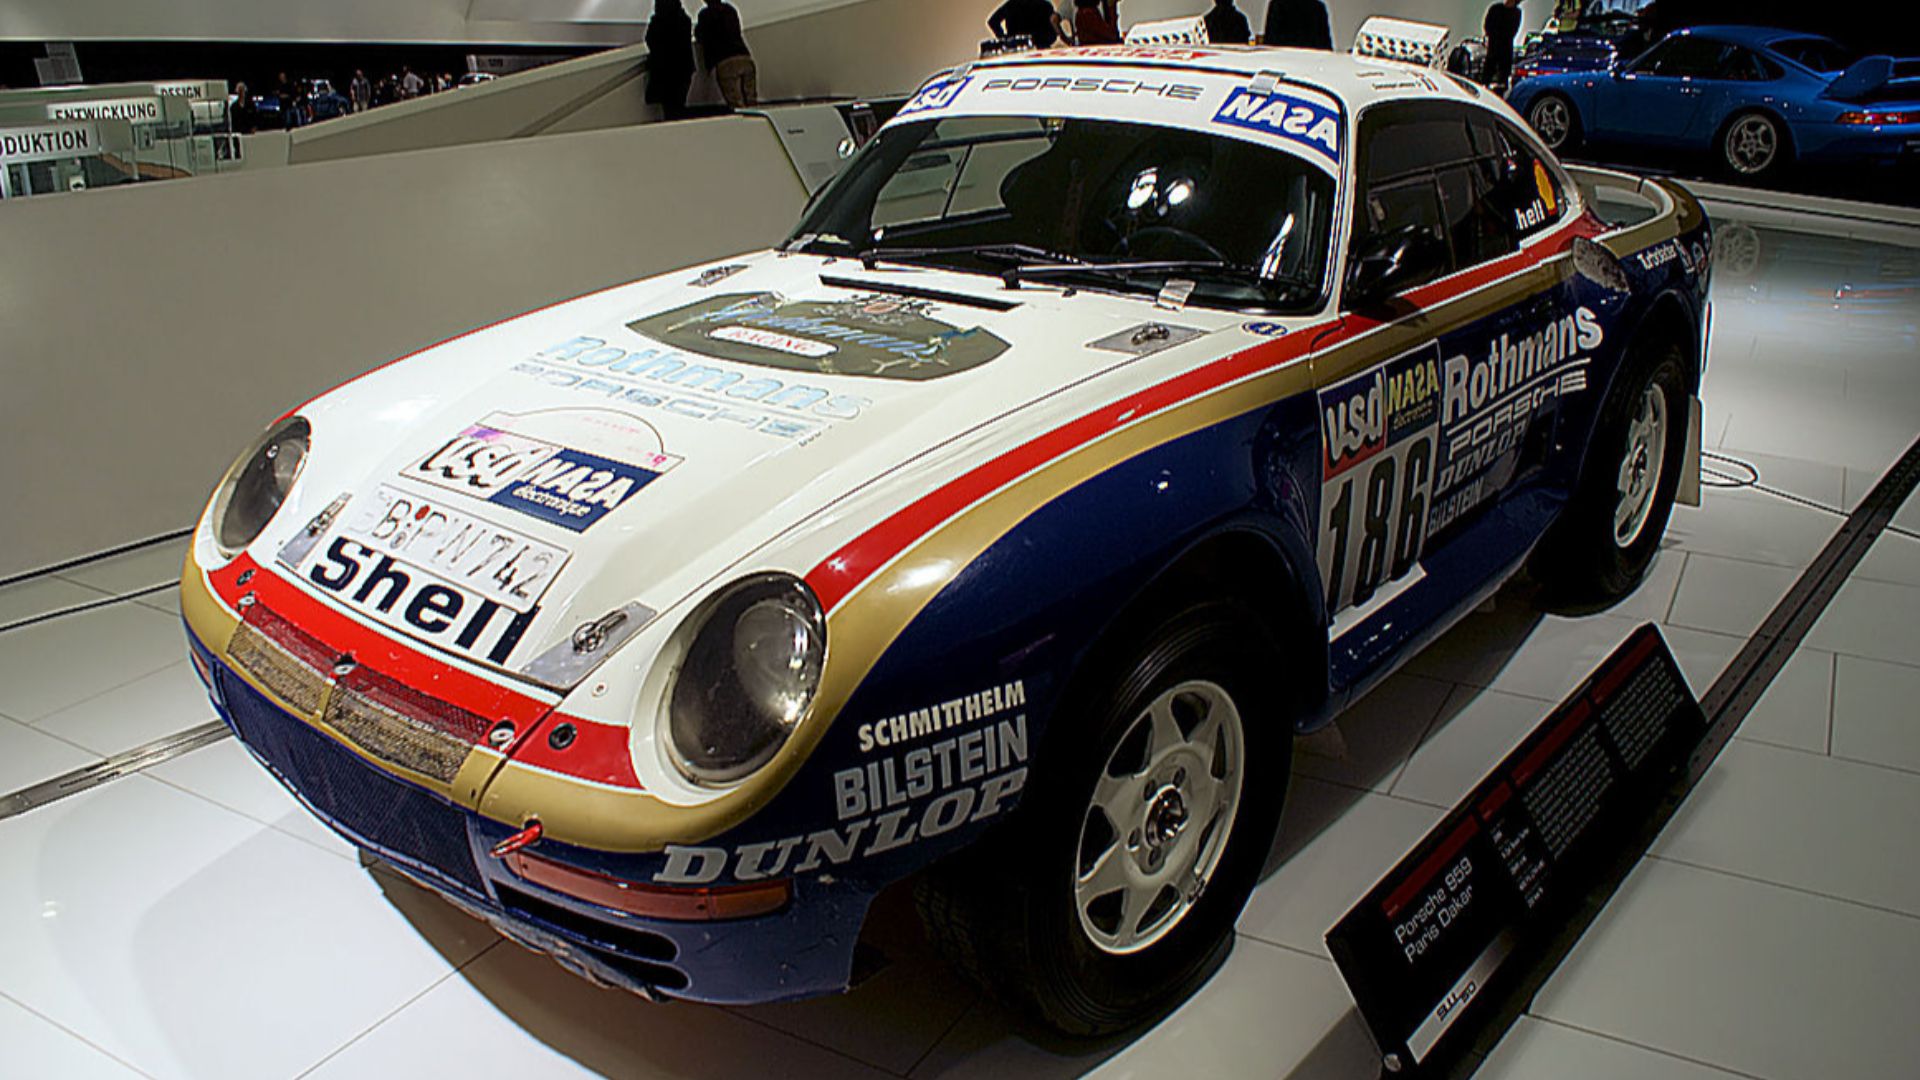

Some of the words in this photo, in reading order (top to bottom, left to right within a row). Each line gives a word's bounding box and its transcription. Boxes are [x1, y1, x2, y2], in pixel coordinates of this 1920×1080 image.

[55, 103, 156, 121] ENTWICKLUNG
[982, 77, 1205, 101] PORSCHE
[536, 335, 873, 420] Rothmans
[1442, 305, 1604, 428] Rothmans
[1448, 369, 1587, 461] PORSCHE
[1325, 441, 1432, 626] 186
[310, 535, 542, 666] Shell
[857, 679, 1026, 753] SCHMITTHELM
[833, 713, 1029, 821] BILSTEIN
[652, 767, 1030, 884] DUNLOP
[1394, 887, 1447, 945] Porsche
[1444, 856, 1474, 892] 959
[1404, 924, 1440, 965] Paris
[1437, 885, 1473, 928] Dakar
